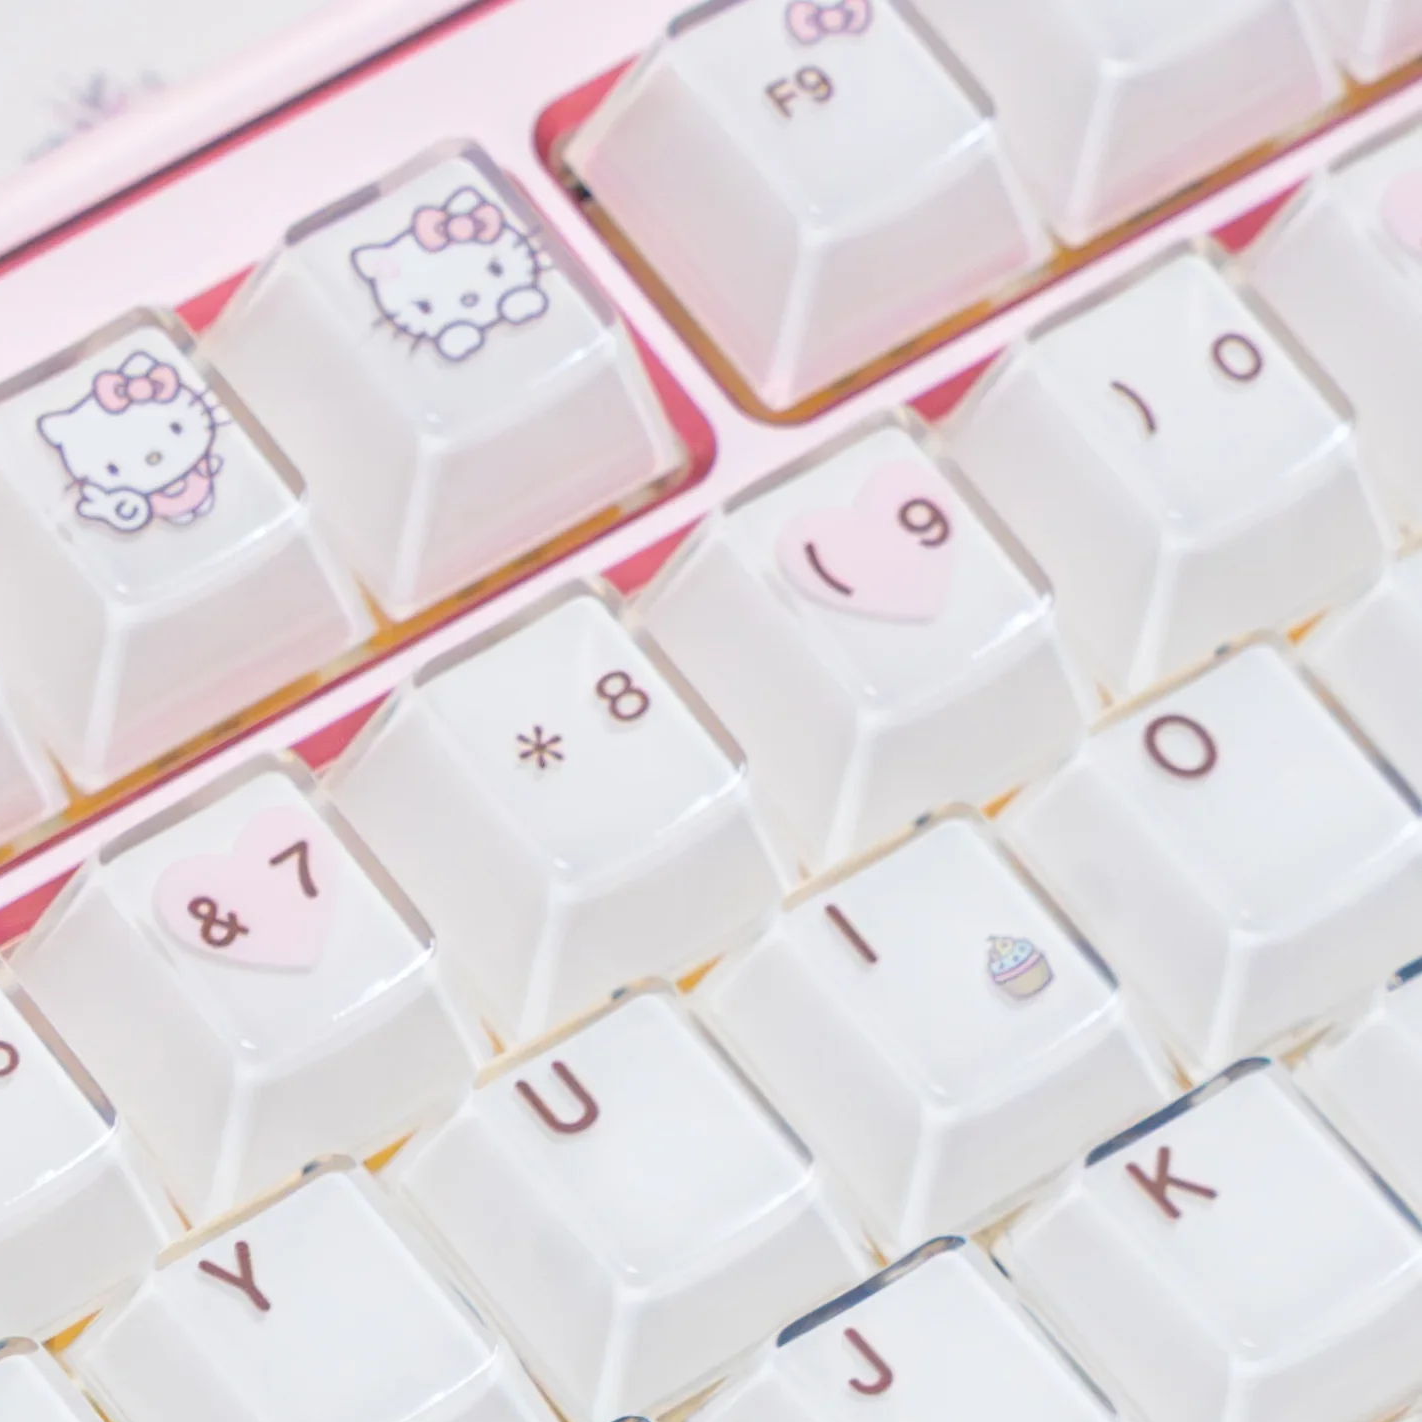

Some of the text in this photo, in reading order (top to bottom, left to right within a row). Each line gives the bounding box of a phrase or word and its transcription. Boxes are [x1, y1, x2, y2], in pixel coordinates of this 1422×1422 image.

[763, 65, 836, 119] F9
[1210, 331, 1265, 384] 0
[896, 496, 952, 549] 9
[594, 669, 652, 723] 8
[1142, 713, 1219, 781] O
[186, 839, 319, 949] & 7
[824, 903, 879, 965] I
[514, 1059, 601, 1136] U
[1124, 1145, 1219, 1221] K
[197, 1239, 272, 1313] Y
[843, 1326, 895, 1397] J
